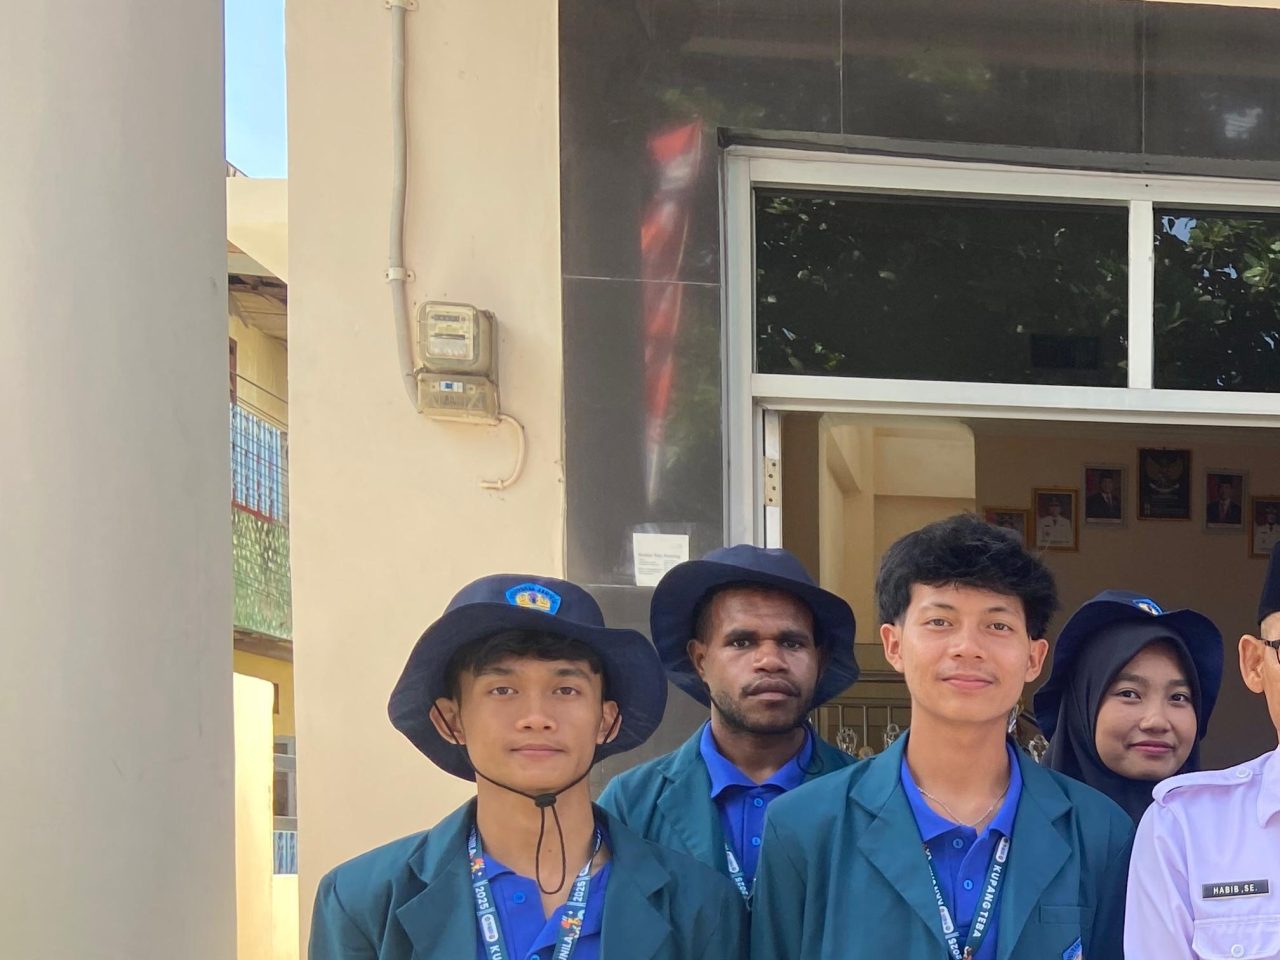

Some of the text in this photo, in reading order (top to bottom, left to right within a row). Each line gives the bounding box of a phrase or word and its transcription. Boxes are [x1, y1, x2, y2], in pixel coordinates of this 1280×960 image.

[475, 886, 489, 911] 2025
[573, 881, 586, 902] 2025
[973, 864, 1002, 937] KUPANG TEBA
[1213, 885, 1239, 895] HABIB
[948, 938, 962, 960] 2025
